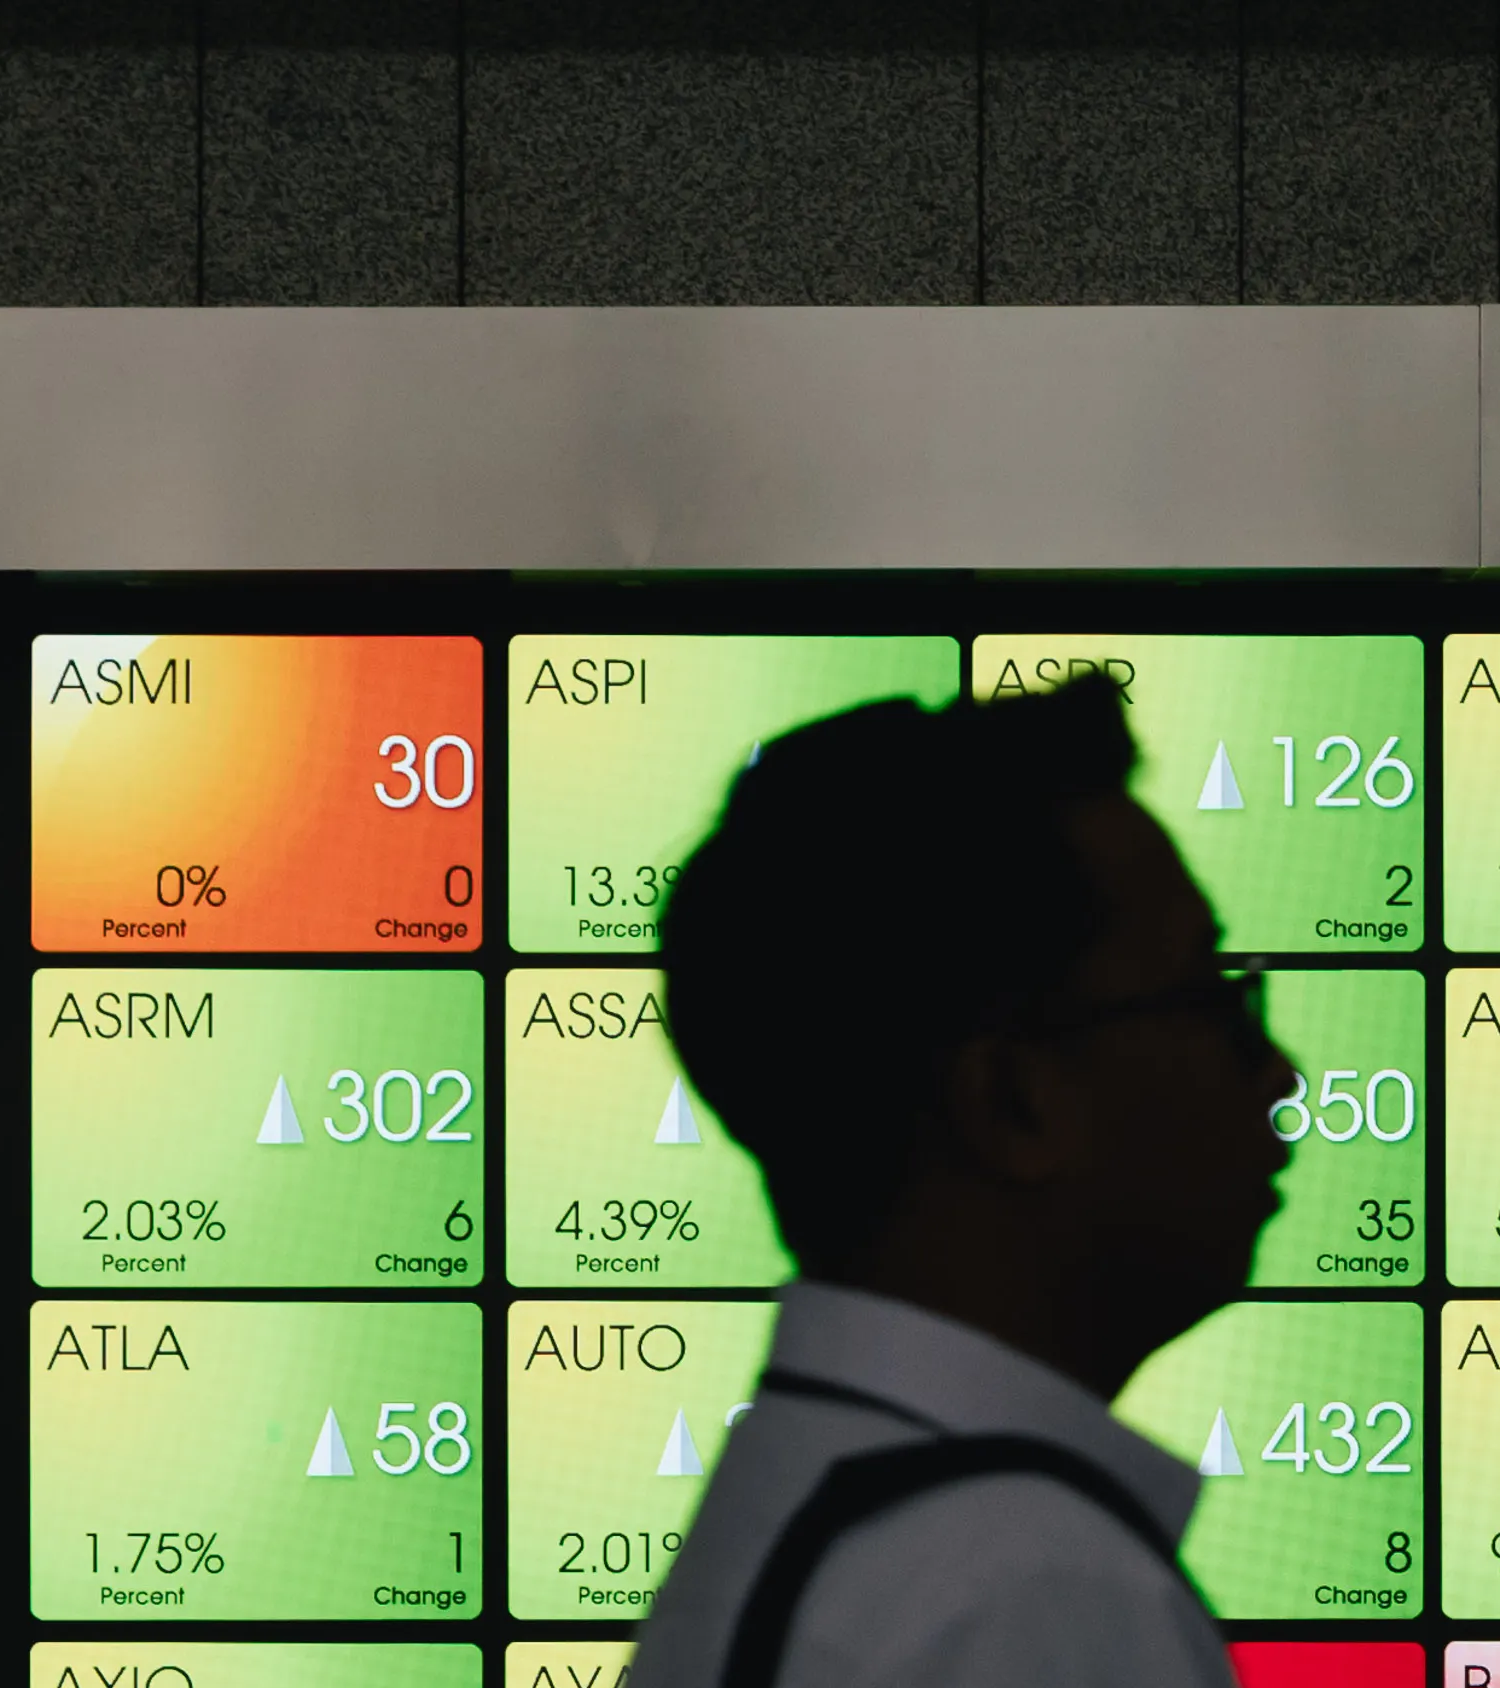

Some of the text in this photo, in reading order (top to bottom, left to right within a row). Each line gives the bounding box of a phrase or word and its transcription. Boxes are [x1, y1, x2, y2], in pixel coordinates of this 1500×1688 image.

[50, 658, 192, 705] ASMI
[526, 659, 645, 705] ASPI
[375, 735, 475, 809] 30
[1273, 736, 1416, 810] 126
[157, 865, 226, 907] 0%
[445, 865, 473, 907] 0
[1386, 865, 1412, 906] 2
[103, 919, 186, 937] Percent
[375, 919, 468, 942] Change
[579, 919, 660, 938] Percen
[1316, 919, 1408, 942] Change
[49, 992, 212, 1039] ASRM
[522, 992, 671, 1040] ASSA
[324, 1070, 474, 1145] 302
[1268, 1068, 1417, 1144] 850
[83, 1200, 226, 1241] 2.03%
[445, 1200, 473, 1241] 6
[555, 1200, 699, 1241] 4.39%
[1357, 1200, 1414, 1241] 35
[103, 1254, 186, 1272] Percent
[375, 1254, 468, 1277] Change
[577, 1254, 660, 1272] Percent
[1317, 1254, 1409, 1277] Change
[47, 1325, 189, 1370] ATLA
[525, 1325, 686, 1372] AUTO
[373, 1402, 473, 1477] 58
[1262, 1402, 1414, 1477] 432
[86, 1533, 224, 1574] 1.75%
[450, 1532, 462, 1573] 1
[1385, 1532, 1412, 1573] 8
[101, 1587, 185, 1605] Percent
[374, 1586, 466, 1610] Change
[579, 1586, 662, 1605] Percen
[1315, 1586, 1407, 1609] Change
